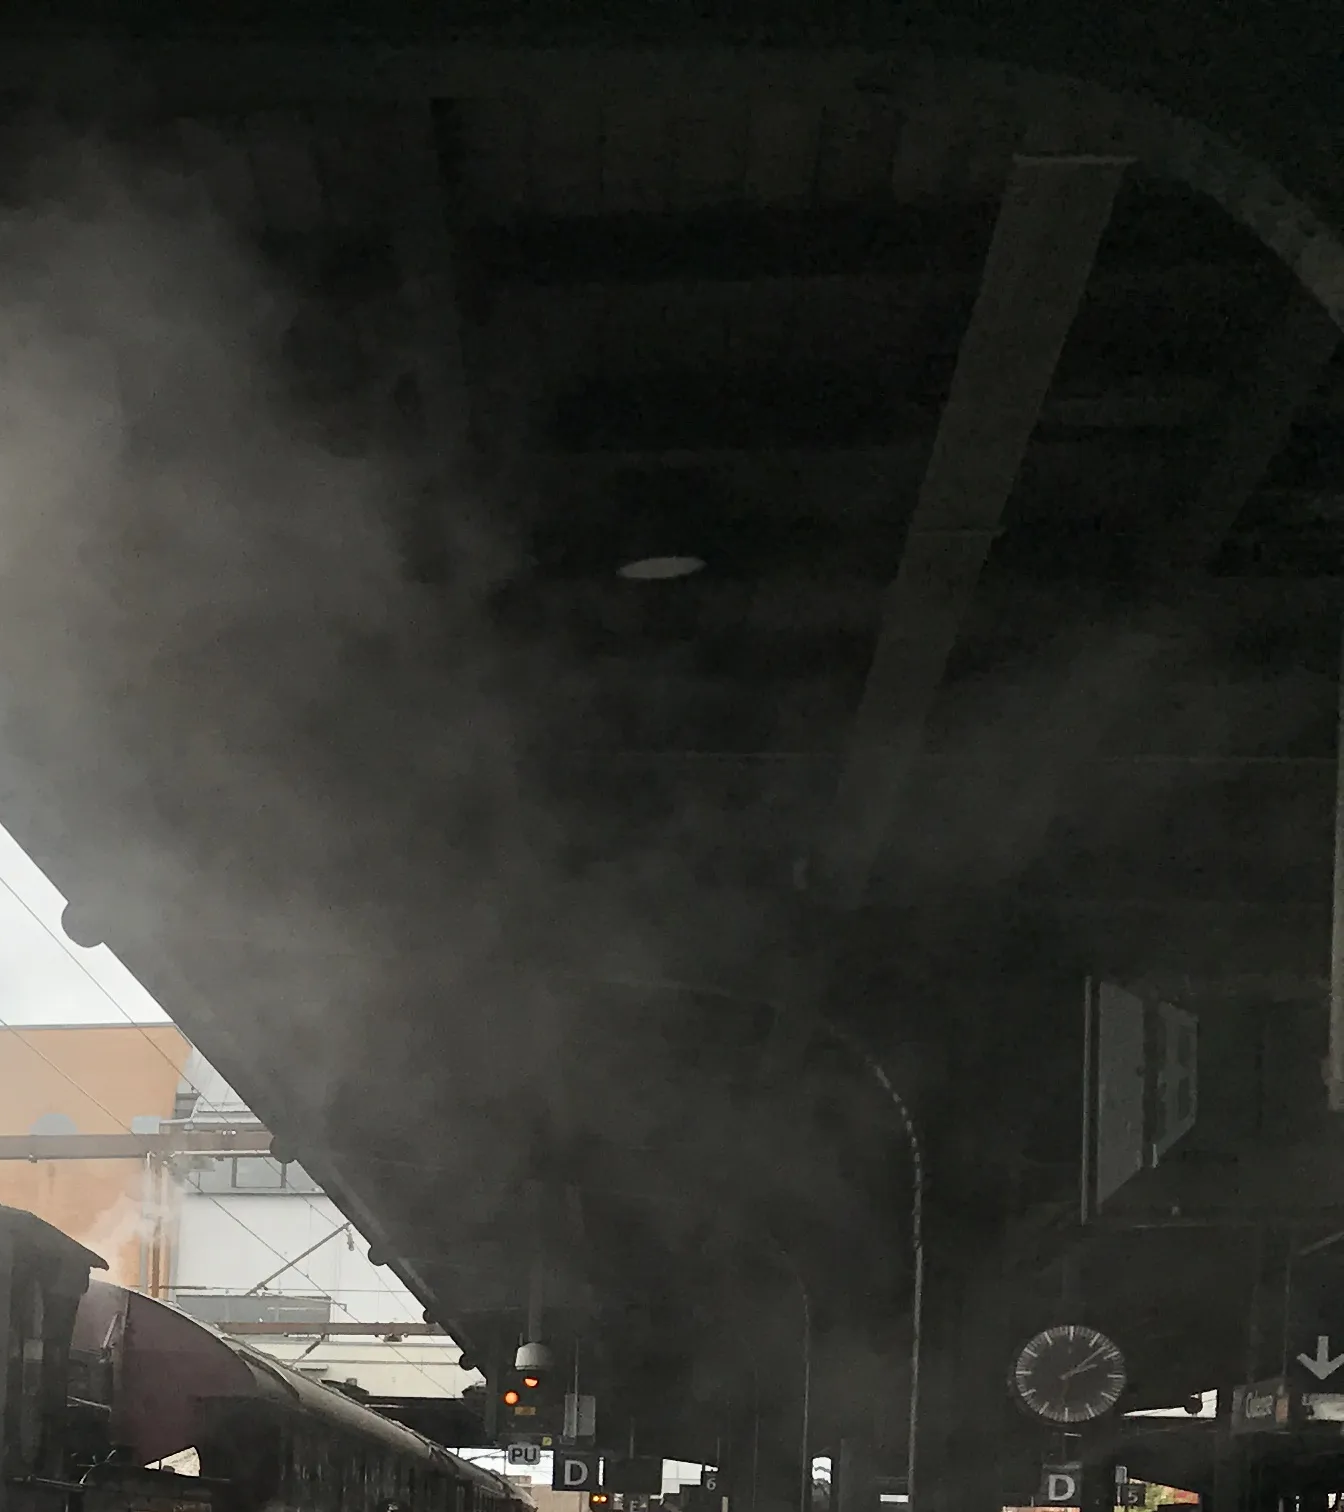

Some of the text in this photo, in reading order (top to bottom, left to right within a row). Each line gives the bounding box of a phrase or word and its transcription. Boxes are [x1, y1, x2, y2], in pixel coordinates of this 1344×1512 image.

[512, 1447, 536, 1462] PU
[564, 1459, 589, 1486] D
[705, 1477, 716, 1491] 6
[1048, 1473, 1076, 1501] D
[1128, 1487, 1138, 1504] 5
